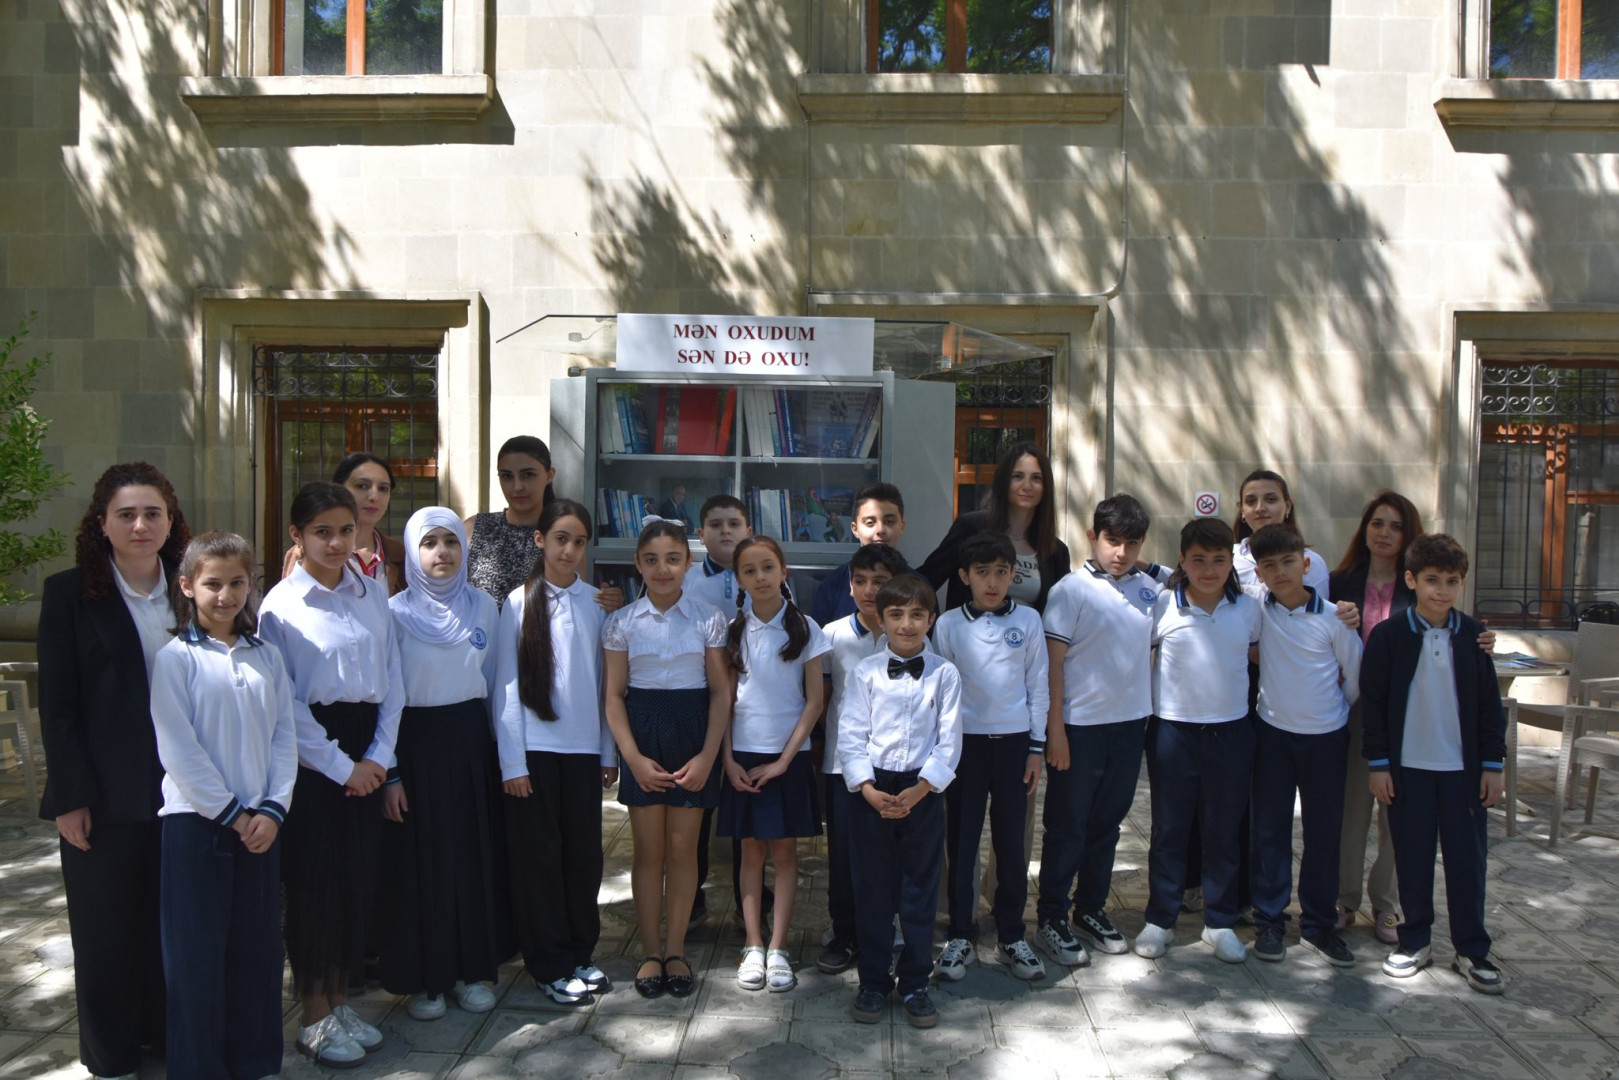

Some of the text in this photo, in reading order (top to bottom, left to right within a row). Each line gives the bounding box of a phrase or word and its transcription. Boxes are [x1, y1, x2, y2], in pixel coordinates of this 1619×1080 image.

[673, 324, 816, 341] MƏN OXUDUM
[677, 349, 809, 367] SƏN DƏ OXU!
[1011, 632, 1018, 641] 8
